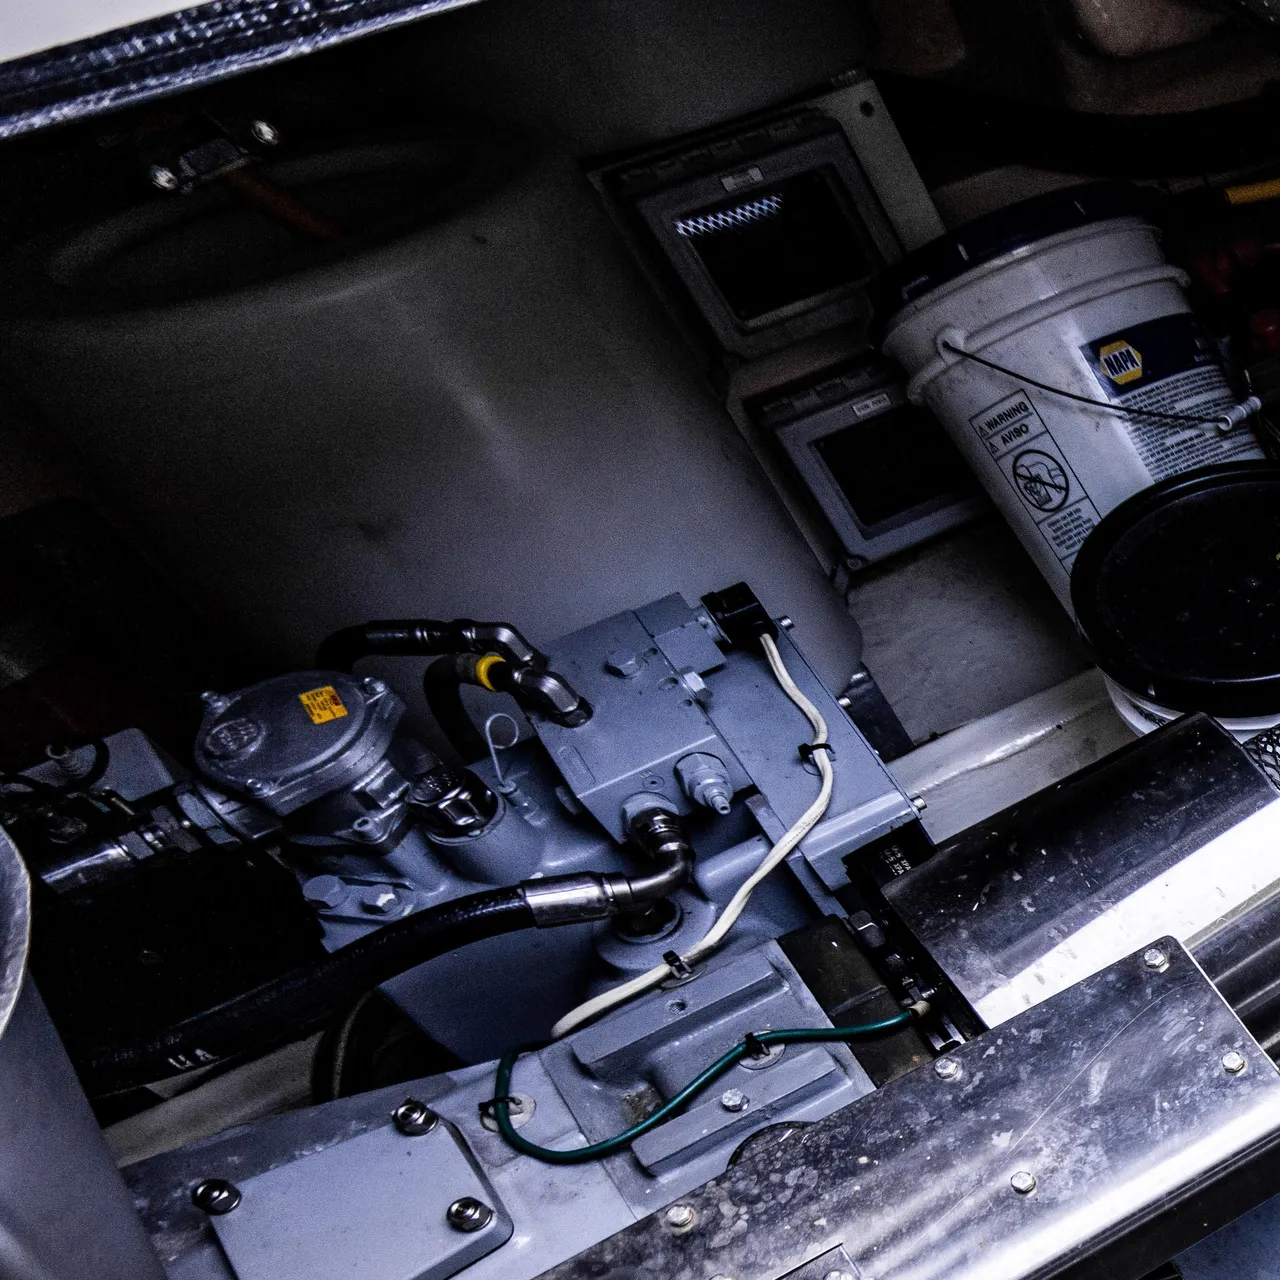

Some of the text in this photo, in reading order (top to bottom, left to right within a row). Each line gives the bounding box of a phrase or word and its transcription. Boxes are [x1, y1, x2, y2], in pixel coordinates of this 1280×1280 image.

[1103, 348, 1140, 377] NAPA
[985, 401, 1030, 432] WARNING
[1001, 423, 1030, 446] AVISO
